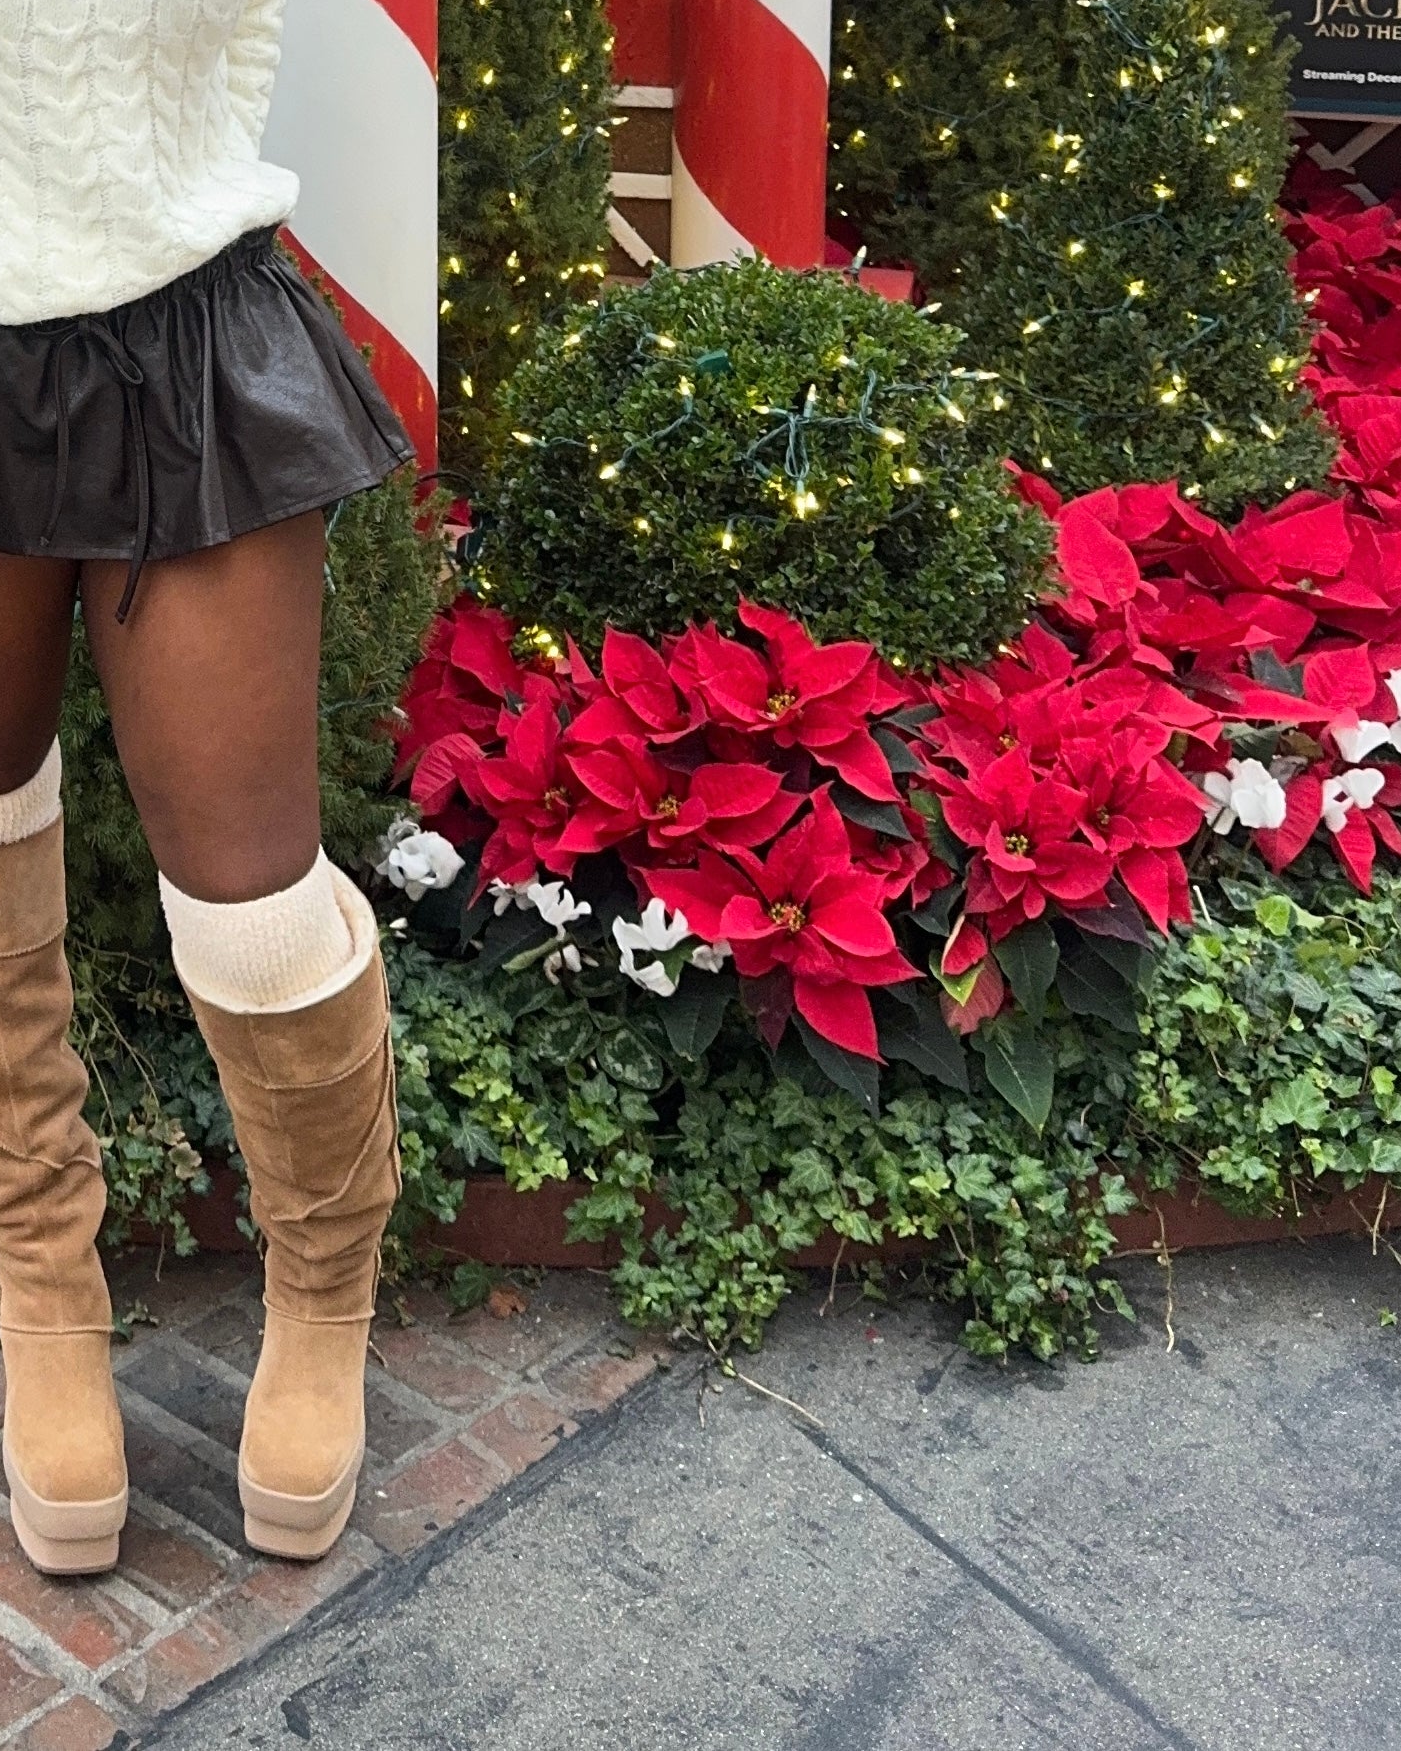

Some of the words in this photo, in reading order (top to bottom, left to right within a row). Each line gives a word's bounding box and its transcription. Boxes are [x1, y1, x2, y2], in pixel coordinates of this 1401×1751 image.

[1315, 23, 1360, 39] AND
[1365, 24, 1401, 41] THE
[1302, 68, 1366, 84] Streaming
[1367, 71, 1401, 84] Dece
